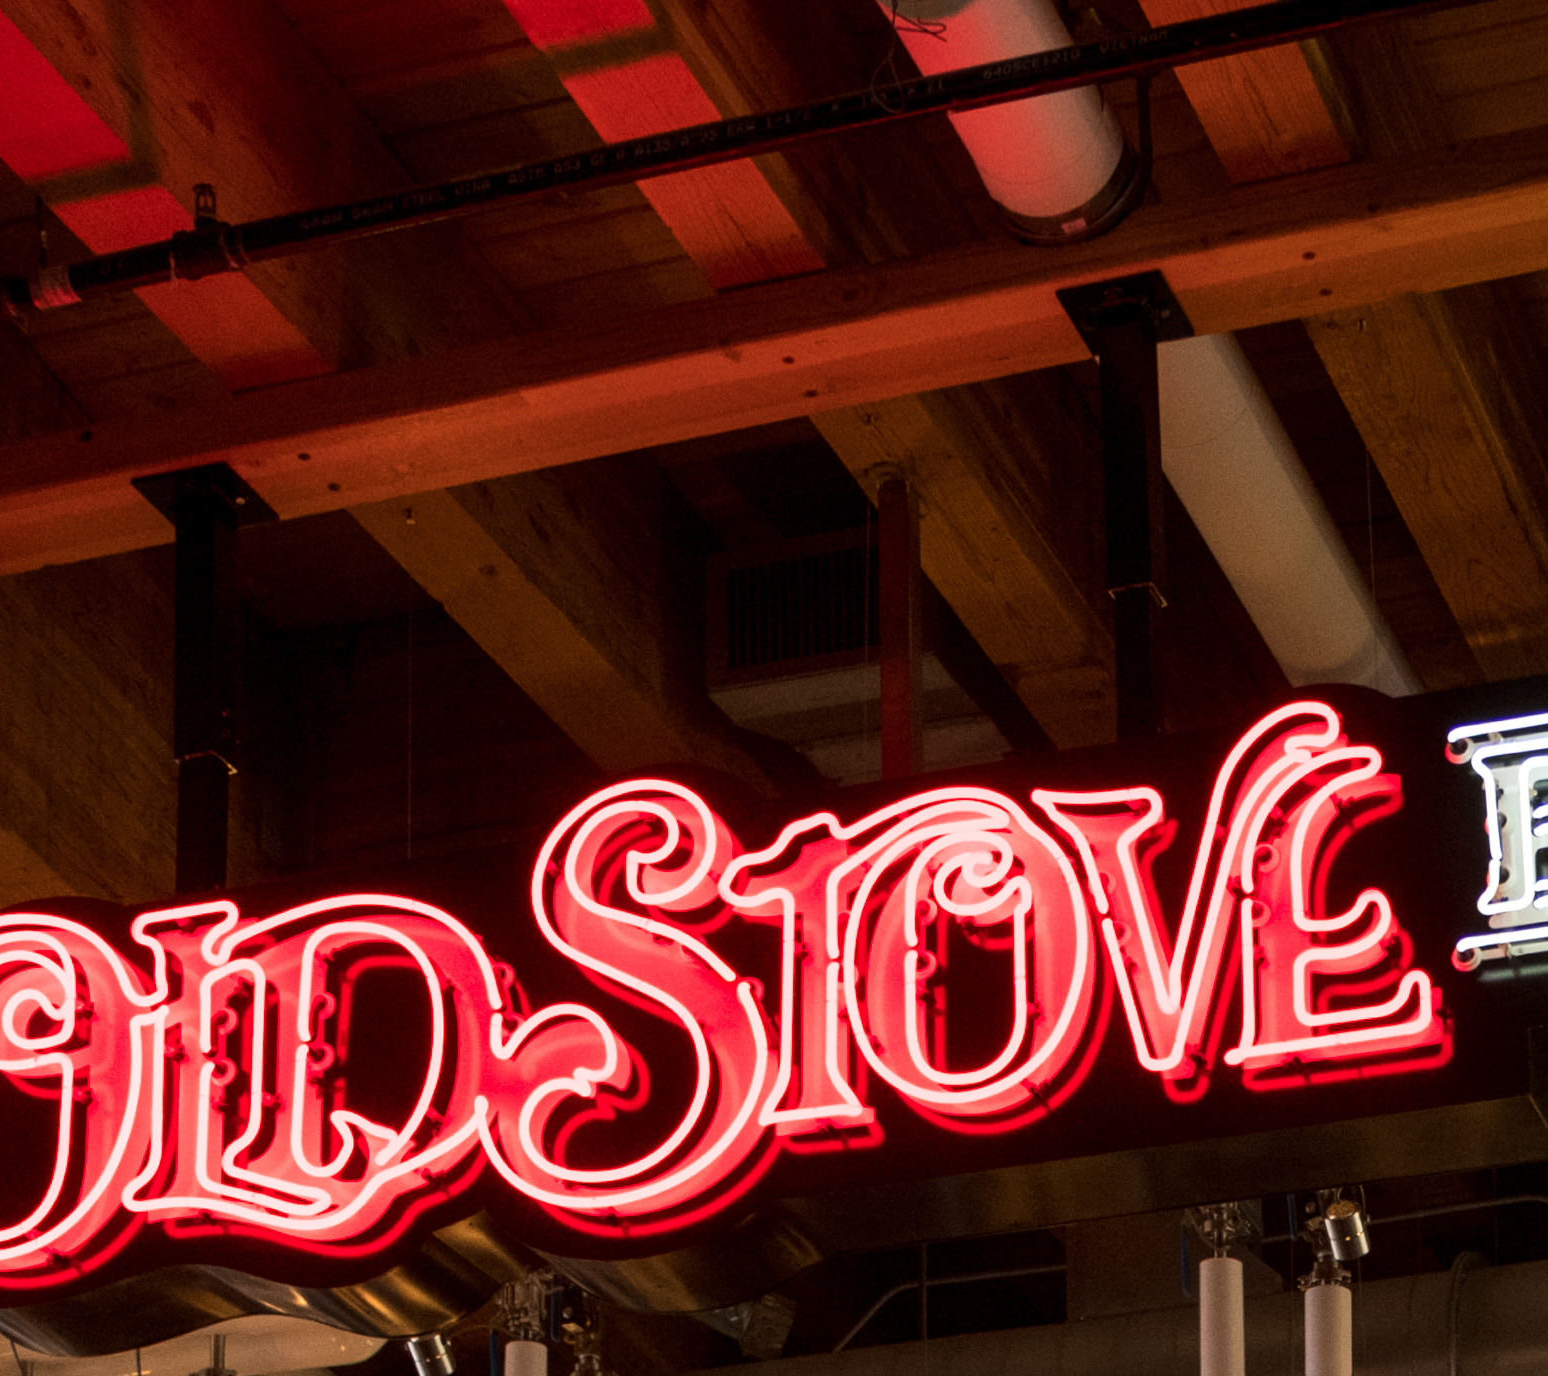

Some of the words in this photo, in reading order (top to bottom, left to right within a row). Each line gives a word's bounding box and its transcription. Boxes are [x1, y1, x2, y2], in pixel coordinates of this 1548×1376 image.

[554, 159, 582, 176] A53
[1100, 28, 1169, 54] VIETNAM
[477, 700, 1452, 1238] STOVE
